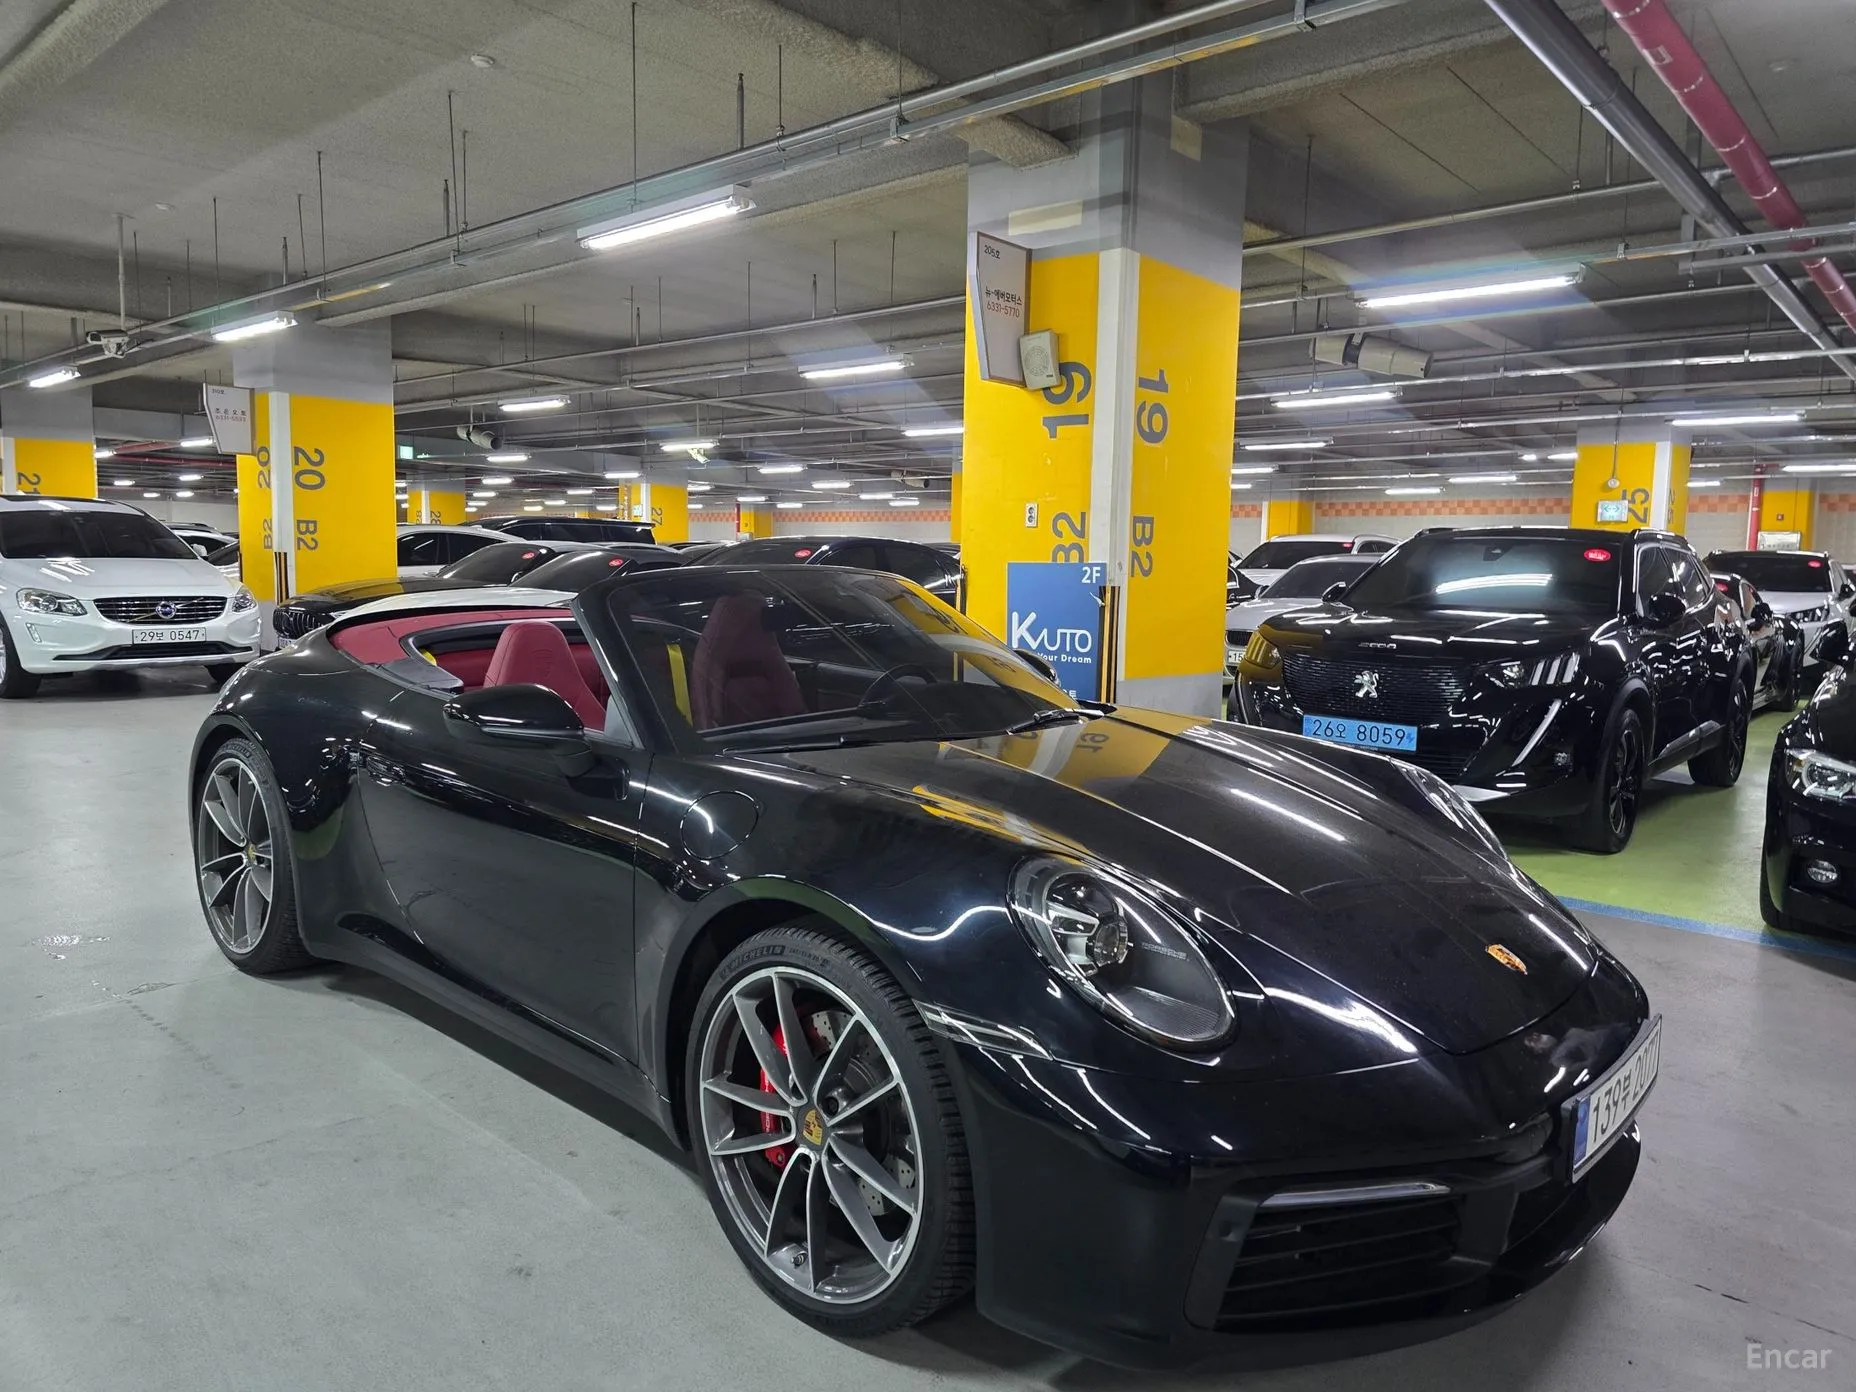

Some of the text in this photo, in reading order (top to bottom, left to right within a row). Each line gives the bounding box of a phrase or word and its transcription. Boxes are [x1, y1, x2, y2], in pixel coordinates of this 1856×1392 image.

[984, 245, 1000, 259] 205호
[987, 302, 1020, 318] 6331-5770
[1136, 368, 1169, 444] 19
[293, 446, 326, 490] 20
[651, 507, 662, 526] 27
[296, 519, 318, 551] B2
[1130, 515, 1154, 578] B2
[1081, 566, 1101, 583] 2F
[140, 630, 199, 642] 29보 0547
[1061, 654, 1092, 663] Dream
[1312, 719, 1406, 746] 26오 8059
[1592, 1068, 1632, 1143] 139부
